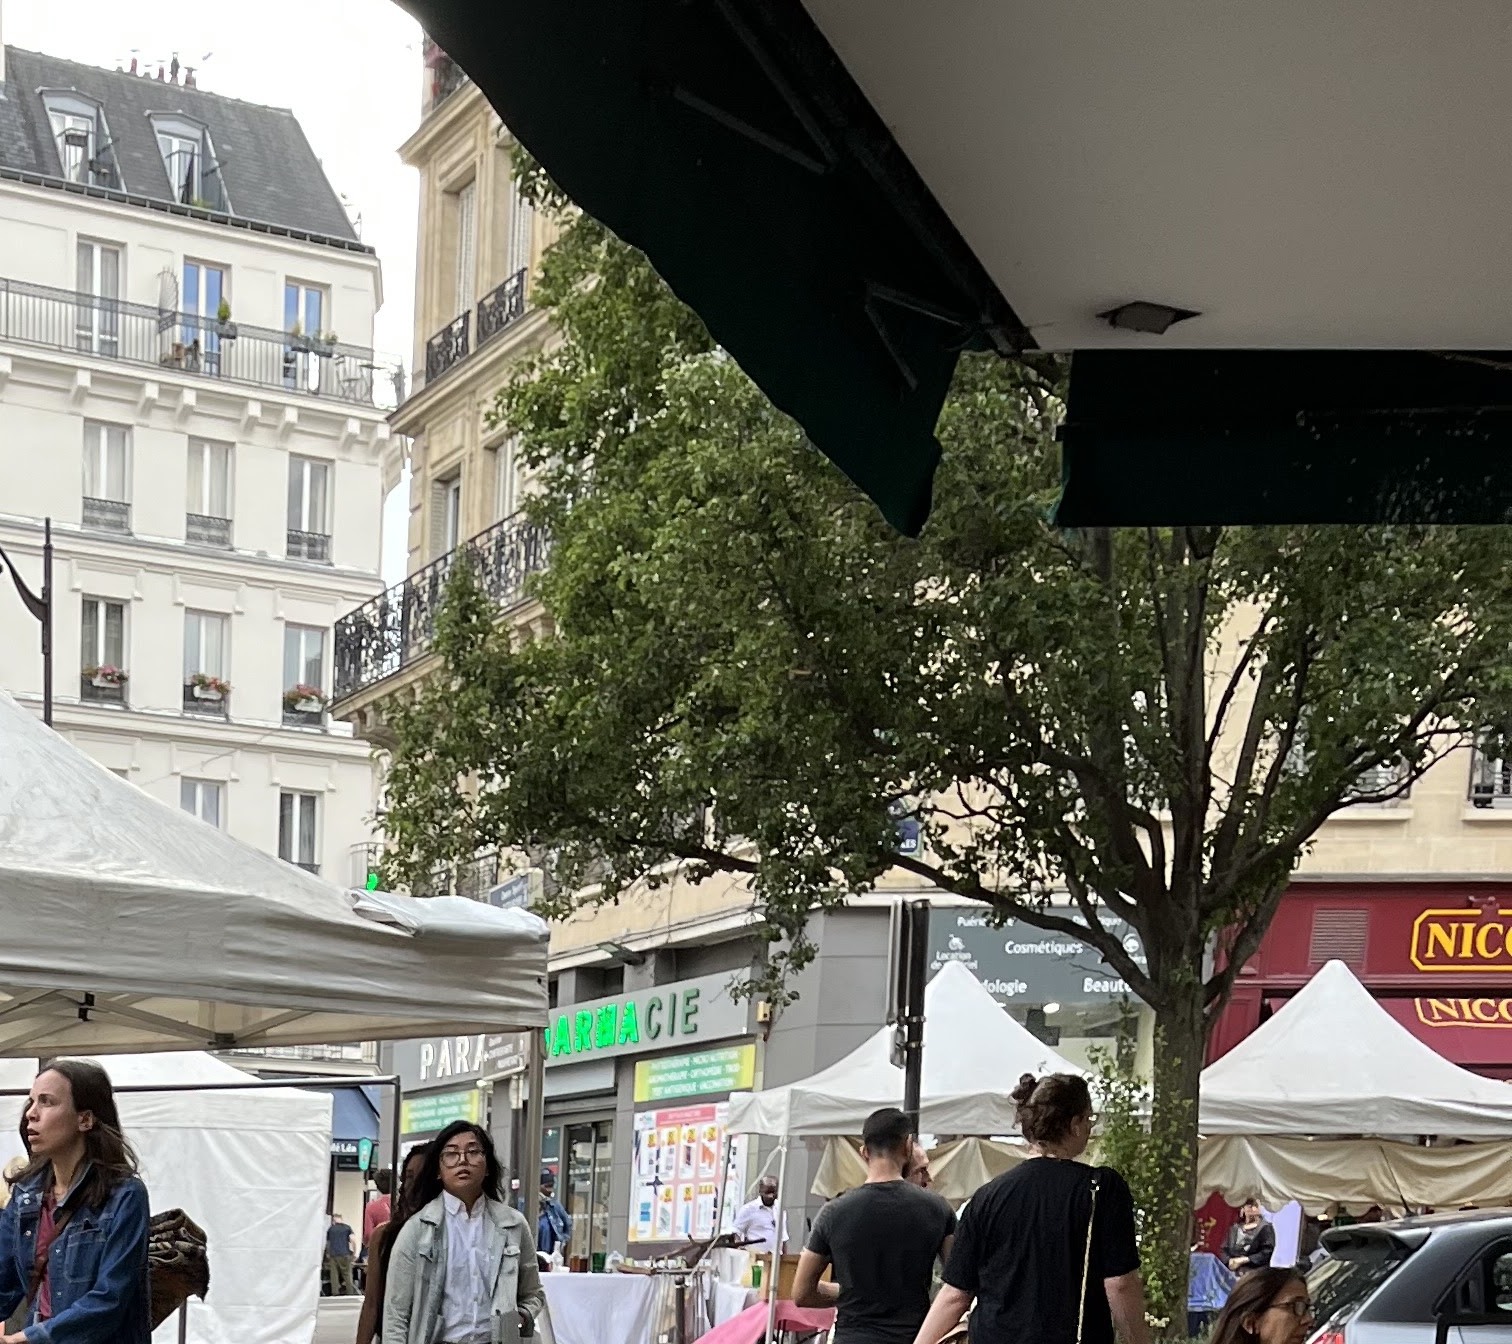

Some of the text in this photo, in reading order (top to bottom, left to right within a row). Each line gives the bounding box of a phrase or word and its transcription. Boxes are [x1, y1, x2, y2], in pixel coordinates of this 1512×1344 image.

[1005, 941, 1083, 955] Cosmétiques
[1425, 922, 1512, 958] NIC
[981, 978, 1028, 996] dologie
[544, 988, 700, 1057] ARMACIE
